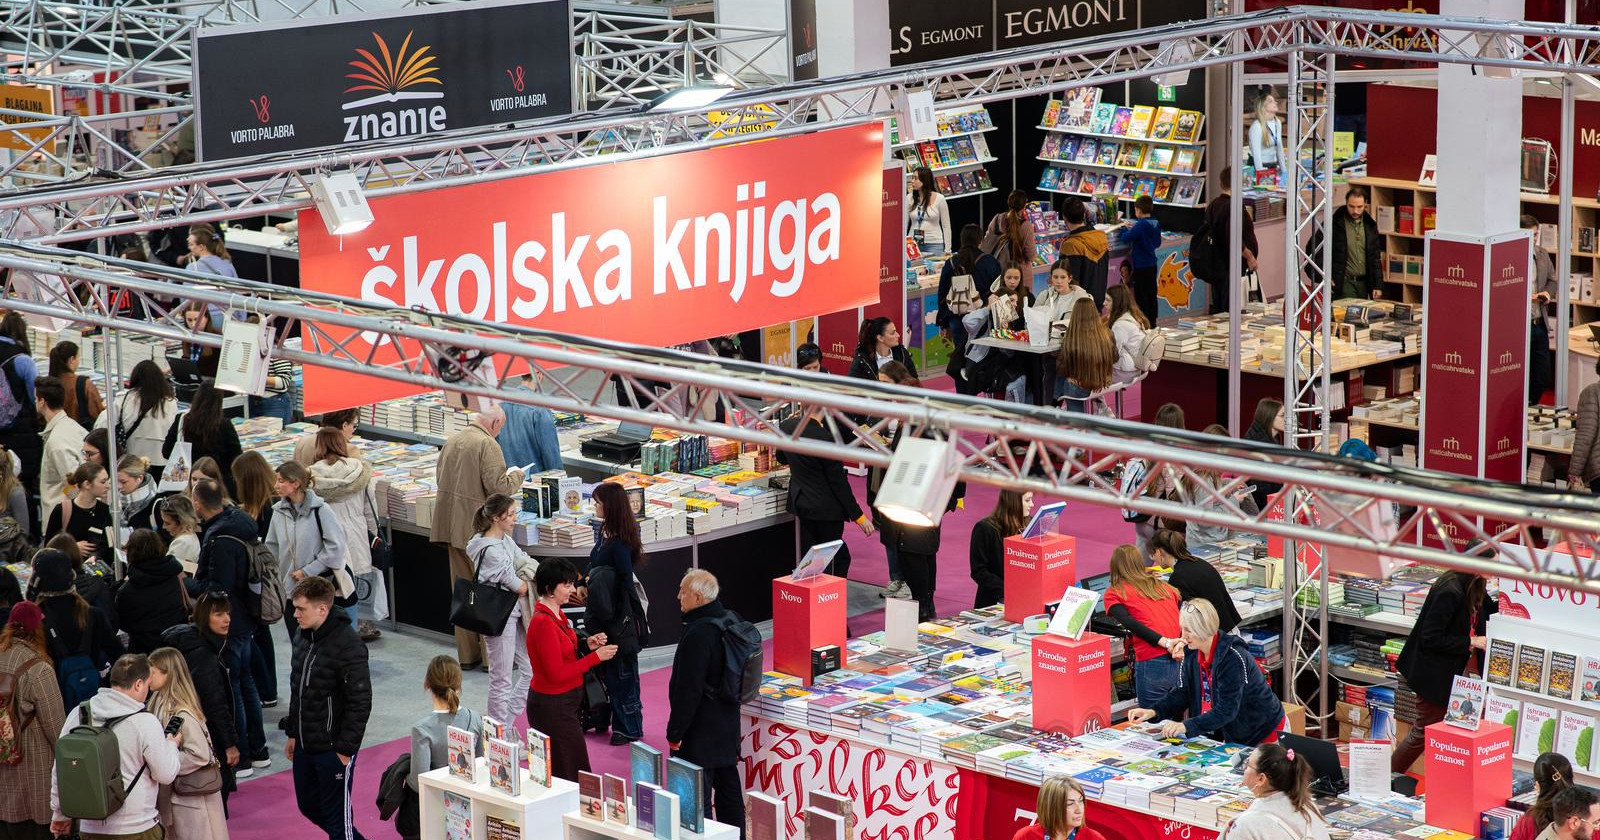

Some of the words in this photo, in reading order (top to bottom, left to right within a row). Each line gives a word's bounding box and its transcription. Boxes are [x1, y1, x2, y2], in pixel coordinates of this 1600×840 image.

[1004, 0, 1127, 38] EGMONT
[921, 25, 984, 45] EGMONT
[490, 97, 514, 111] VORTO
[515, 93, 547, 109] PALABRA
[231, 128, 258, 144] VORTO
[259, 124, 295, 141] PALABRA
[360, 212, 632, 346] školska
[653, 180, 841, 303] knjiga
[1434, 277, 1478, 288] maticahrvatska
[1431, 364, 1475, 375] maticahrvatska
[1429, 449, 1473, 460] maticahrvatska
[1007, 548, 1038, 561] Društvene
[1044, 548, 1072, 561] Društvene
[1009, 559, 1036, 570] znanosti
[1046, 558, 1070, 570] znanosti
[780, 590, 802, 604] Novo
[818, 592, 839, 604] Novo
[1037, 649, 1067, 663] Prirodne
[1078, 650, 1105, 663] Prirodne
[1038, 661, 1067, 674] znanosti
[1079, 660, 1105, 674] znanosti
[1456, 679, 1482, 693] HRANA
[1489, 706, 1503, 714] bilja
[1490, 698, 1513, 709] Ishrana
[1526, 714, 1540, 722] bilja
[1527, 707, 1551, 718] Ishrana
[1563, 723, 1577, 731] bilja
[1564, 715, 1588, 727] Ishrana
[448, 730, 469, 745] HRANA
[490, 742, 510, 757] HRANA
[1430, 738, 1470, 756] Popularna
[1477, 740, 1510, 756] Popularna
[1434, 753, 1465, 766] znanost
[1481, 753, 1506, 766] znanost
